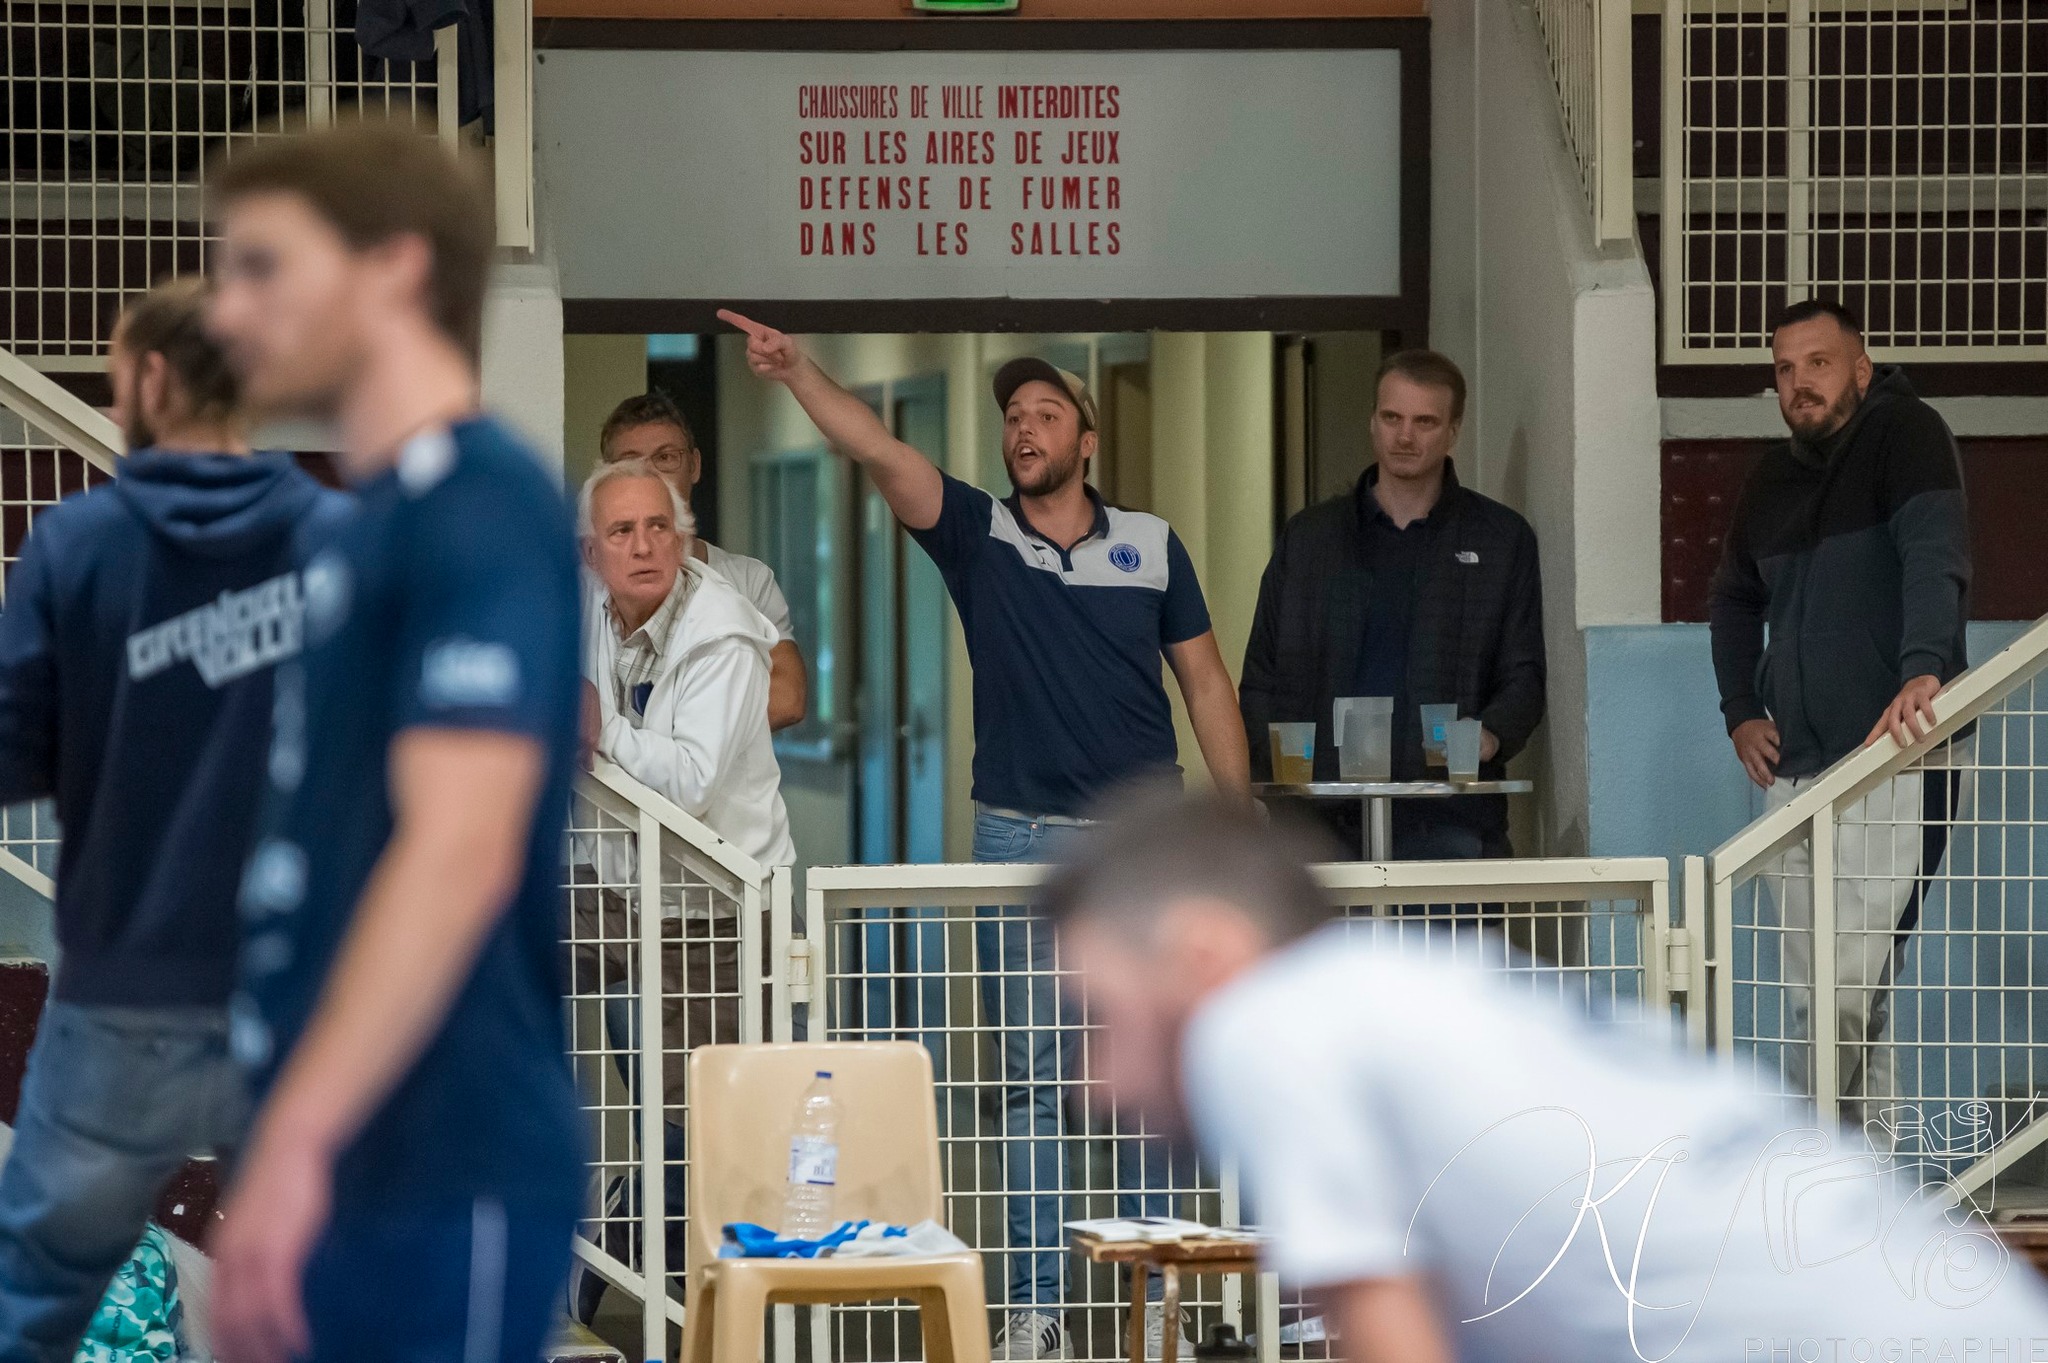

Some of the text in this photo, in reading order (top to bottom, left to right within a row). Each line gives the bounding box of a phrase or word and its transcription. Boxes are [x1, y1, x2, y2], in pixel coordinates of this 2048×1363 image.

[798, 84, 1120, 119] CHAUSSURES DE VILLE INTERDITES
[799, 131, 1120, 164] SUR LES AIRES DE JEUX
[799, 176, 1120, 210] DEFENSE DE FUMER
[799, 221, 1120, 255] DANS LES SALLES
